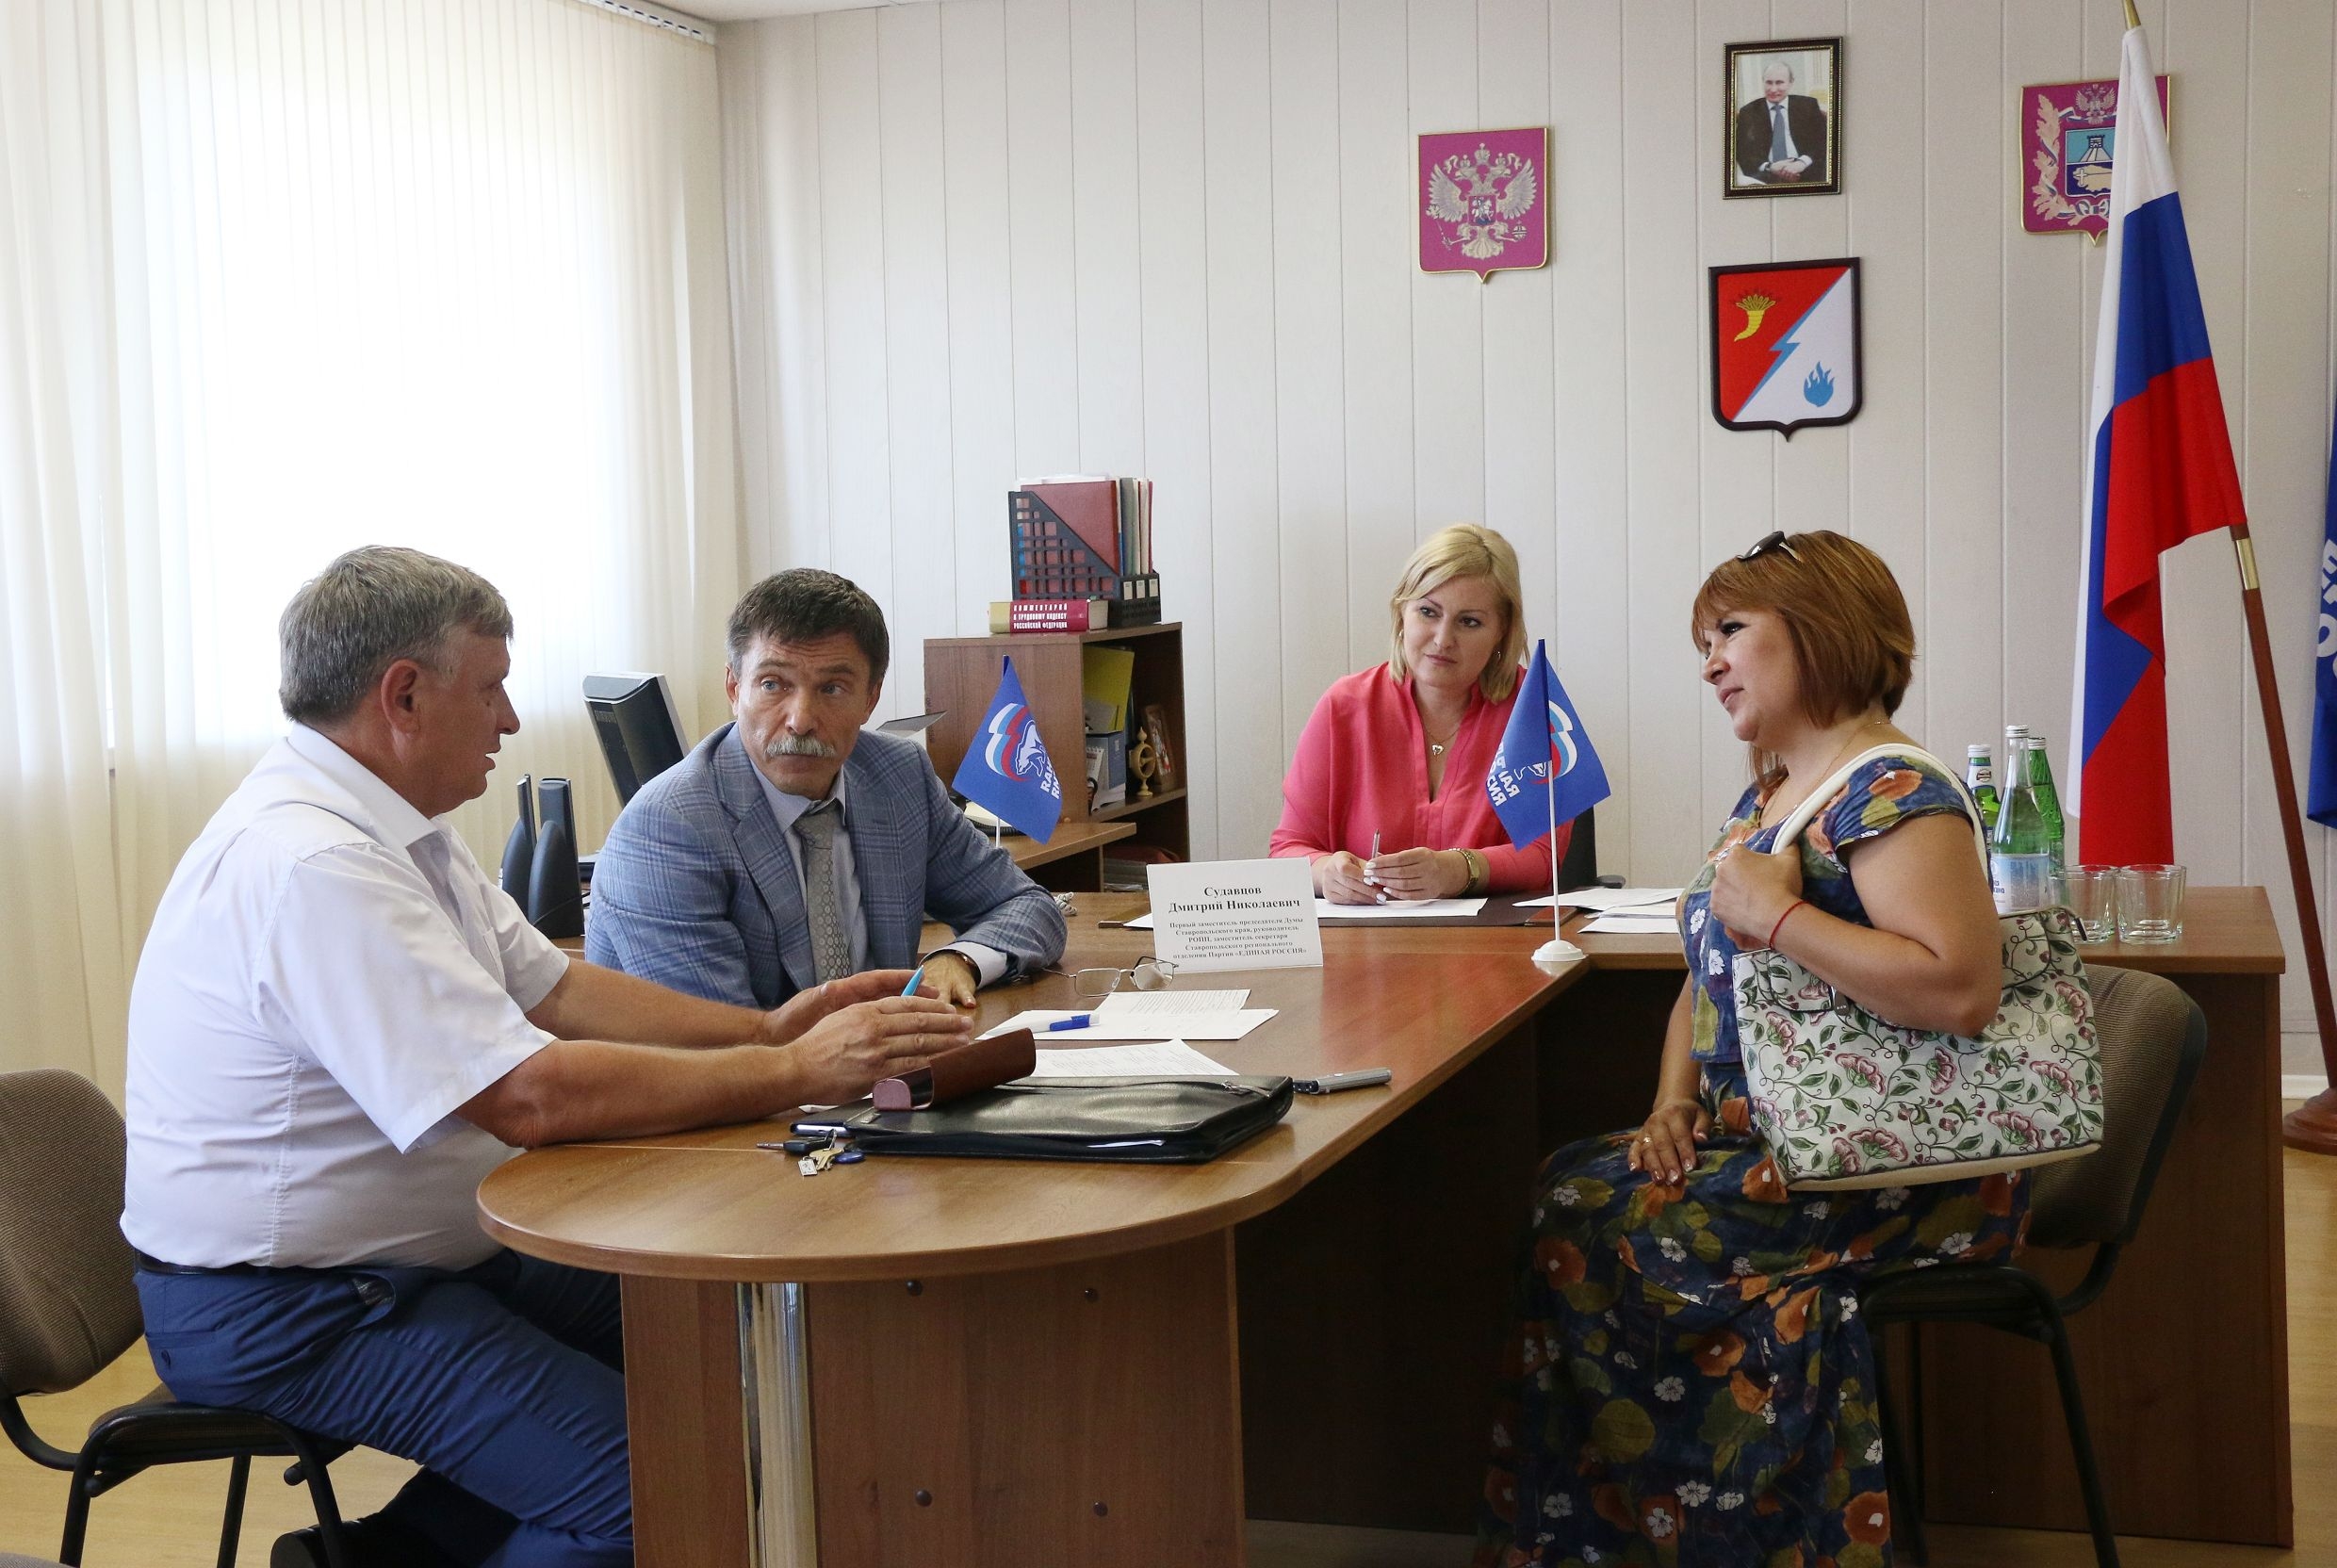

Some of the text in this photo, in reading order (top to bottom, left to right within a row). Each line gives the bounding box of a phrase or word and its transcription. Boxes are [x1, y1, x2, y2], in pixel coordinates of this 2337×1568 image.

[1013, 621, 1068, 629] РОССИЙСКОЙ ФЕДЕРАЦИИ
[1203, 887, 1262, 898] Судавцов
[1168, 899, 1300, 913] Дмитрий Николаевич
